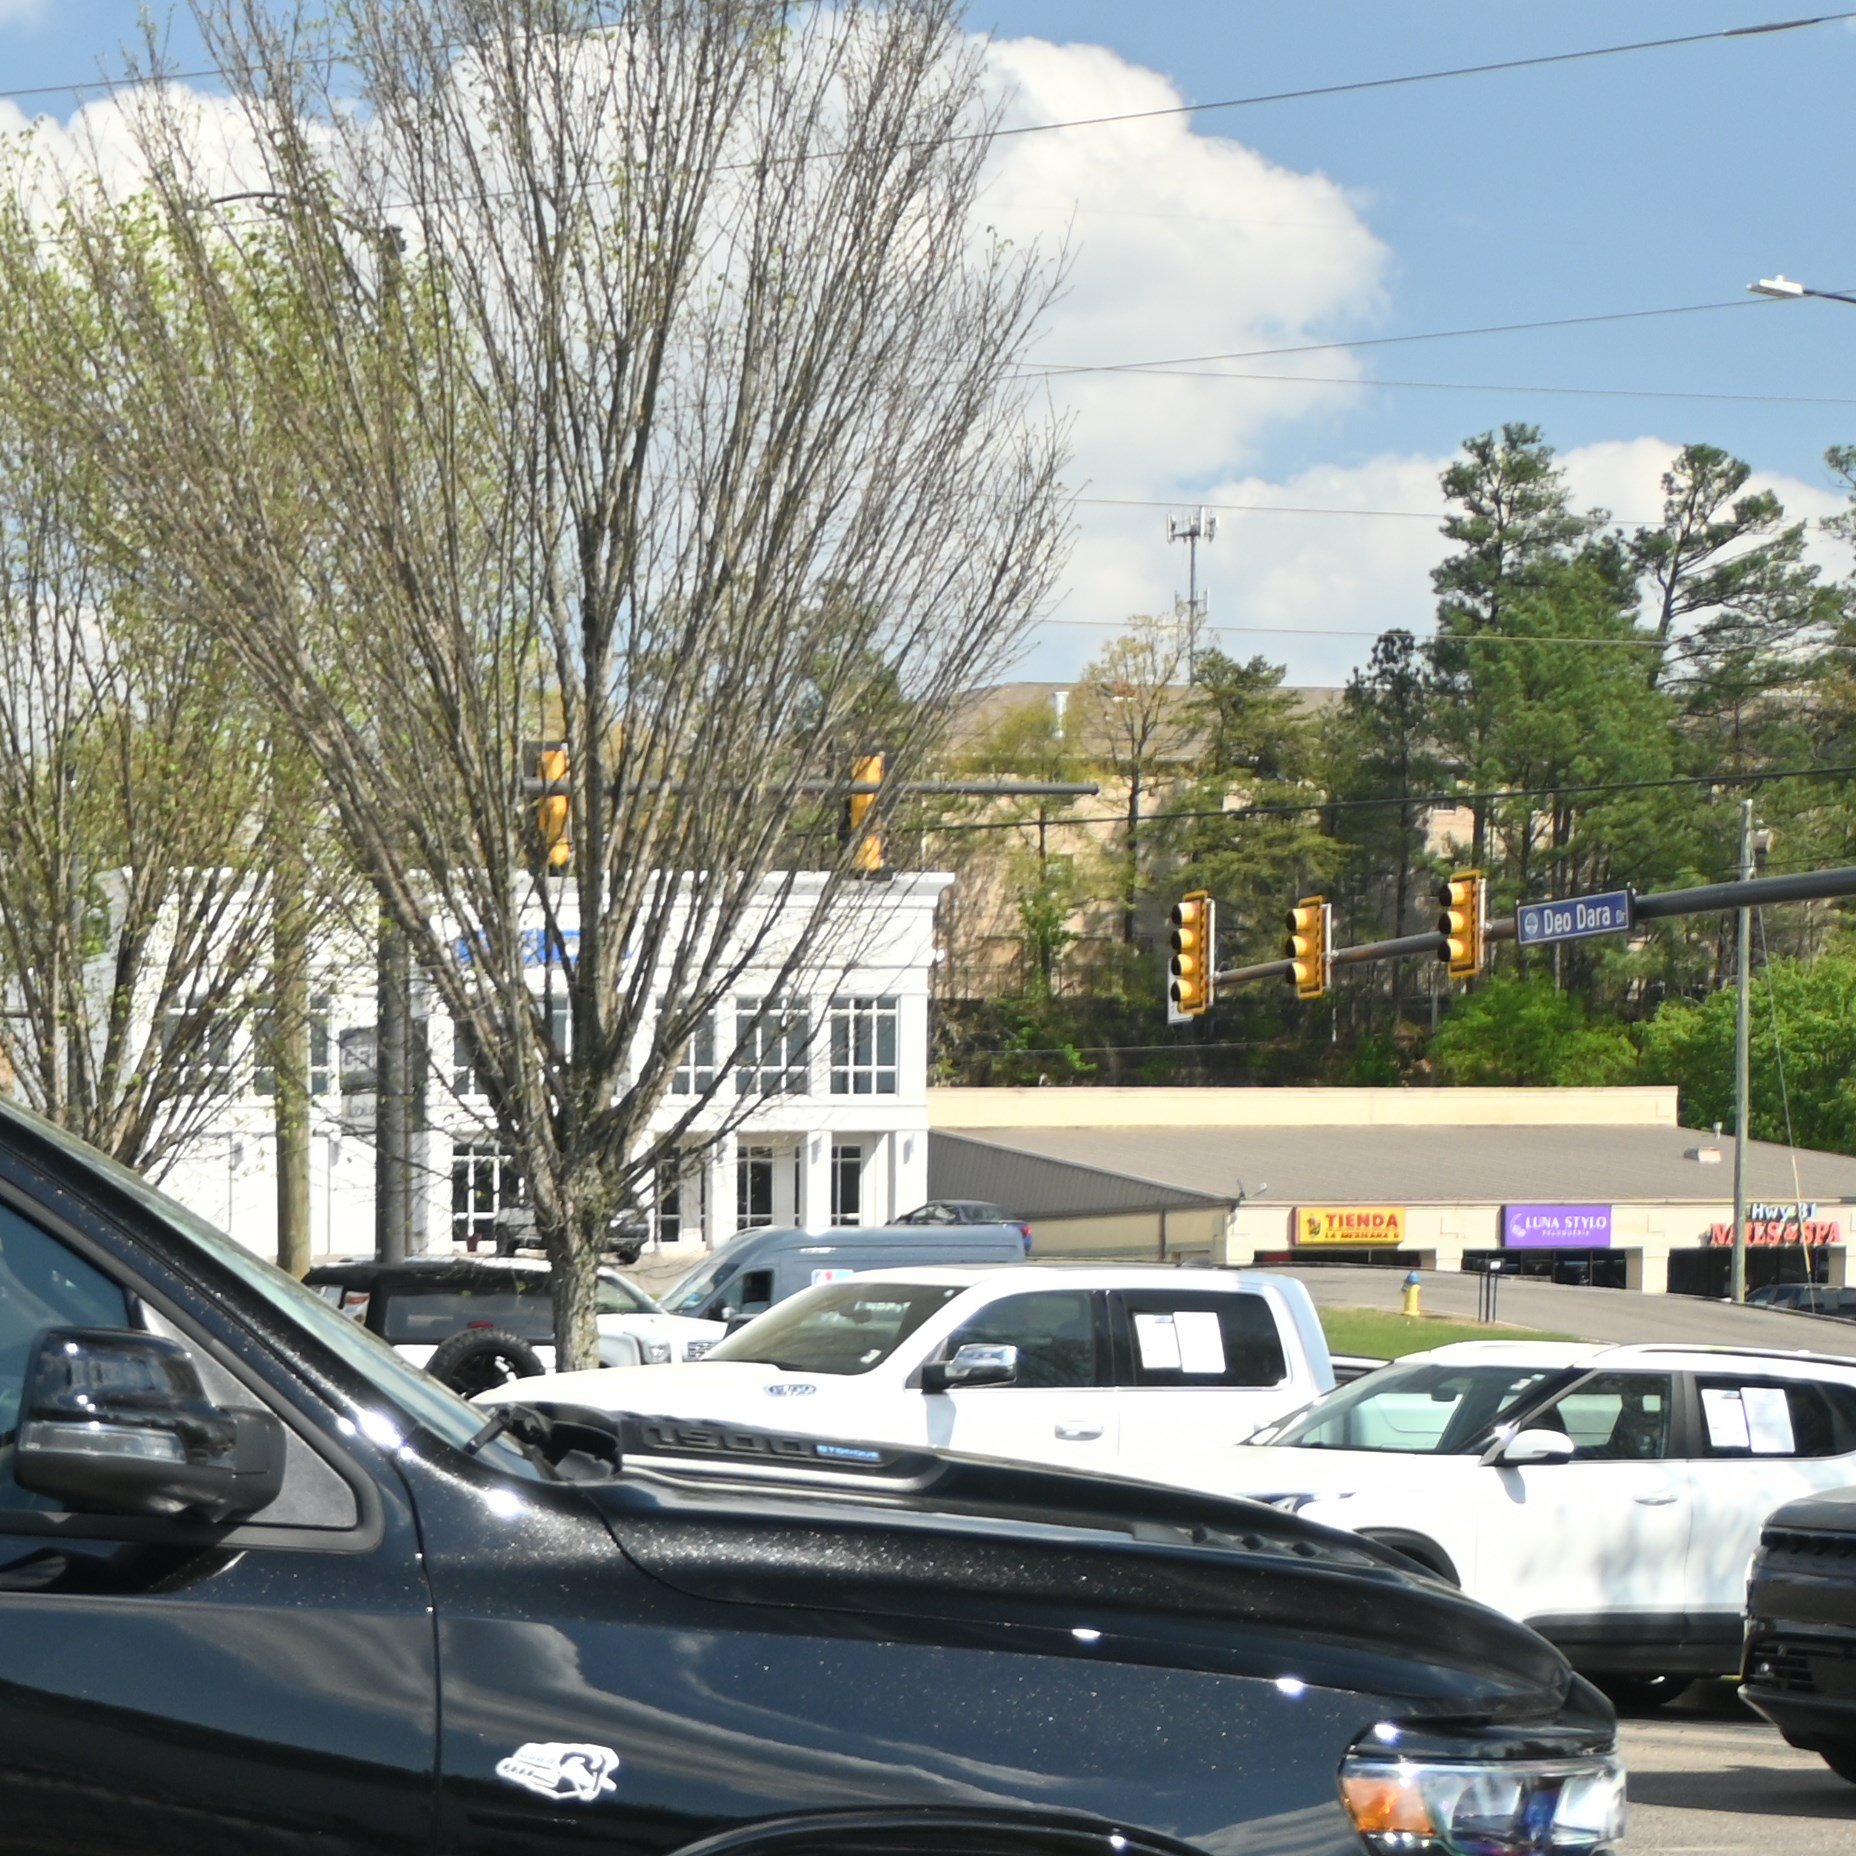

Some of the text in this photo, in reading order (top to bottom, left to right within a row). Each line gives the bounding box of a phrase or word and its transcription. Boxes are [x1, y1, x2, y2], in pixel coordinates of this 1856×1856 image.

[1544, 903, 1626, 935] Deo Dara Dr
[1325, 1213, 1398, 1228] TIENDA
[1751, 1202, 1795, 1221] Hwy
[1525, 1216, 1607, 1229] LUNA STYLO
[1800, 1221, 1841, 1245] SPA
[643, 1421, 814, 1457] 1500
